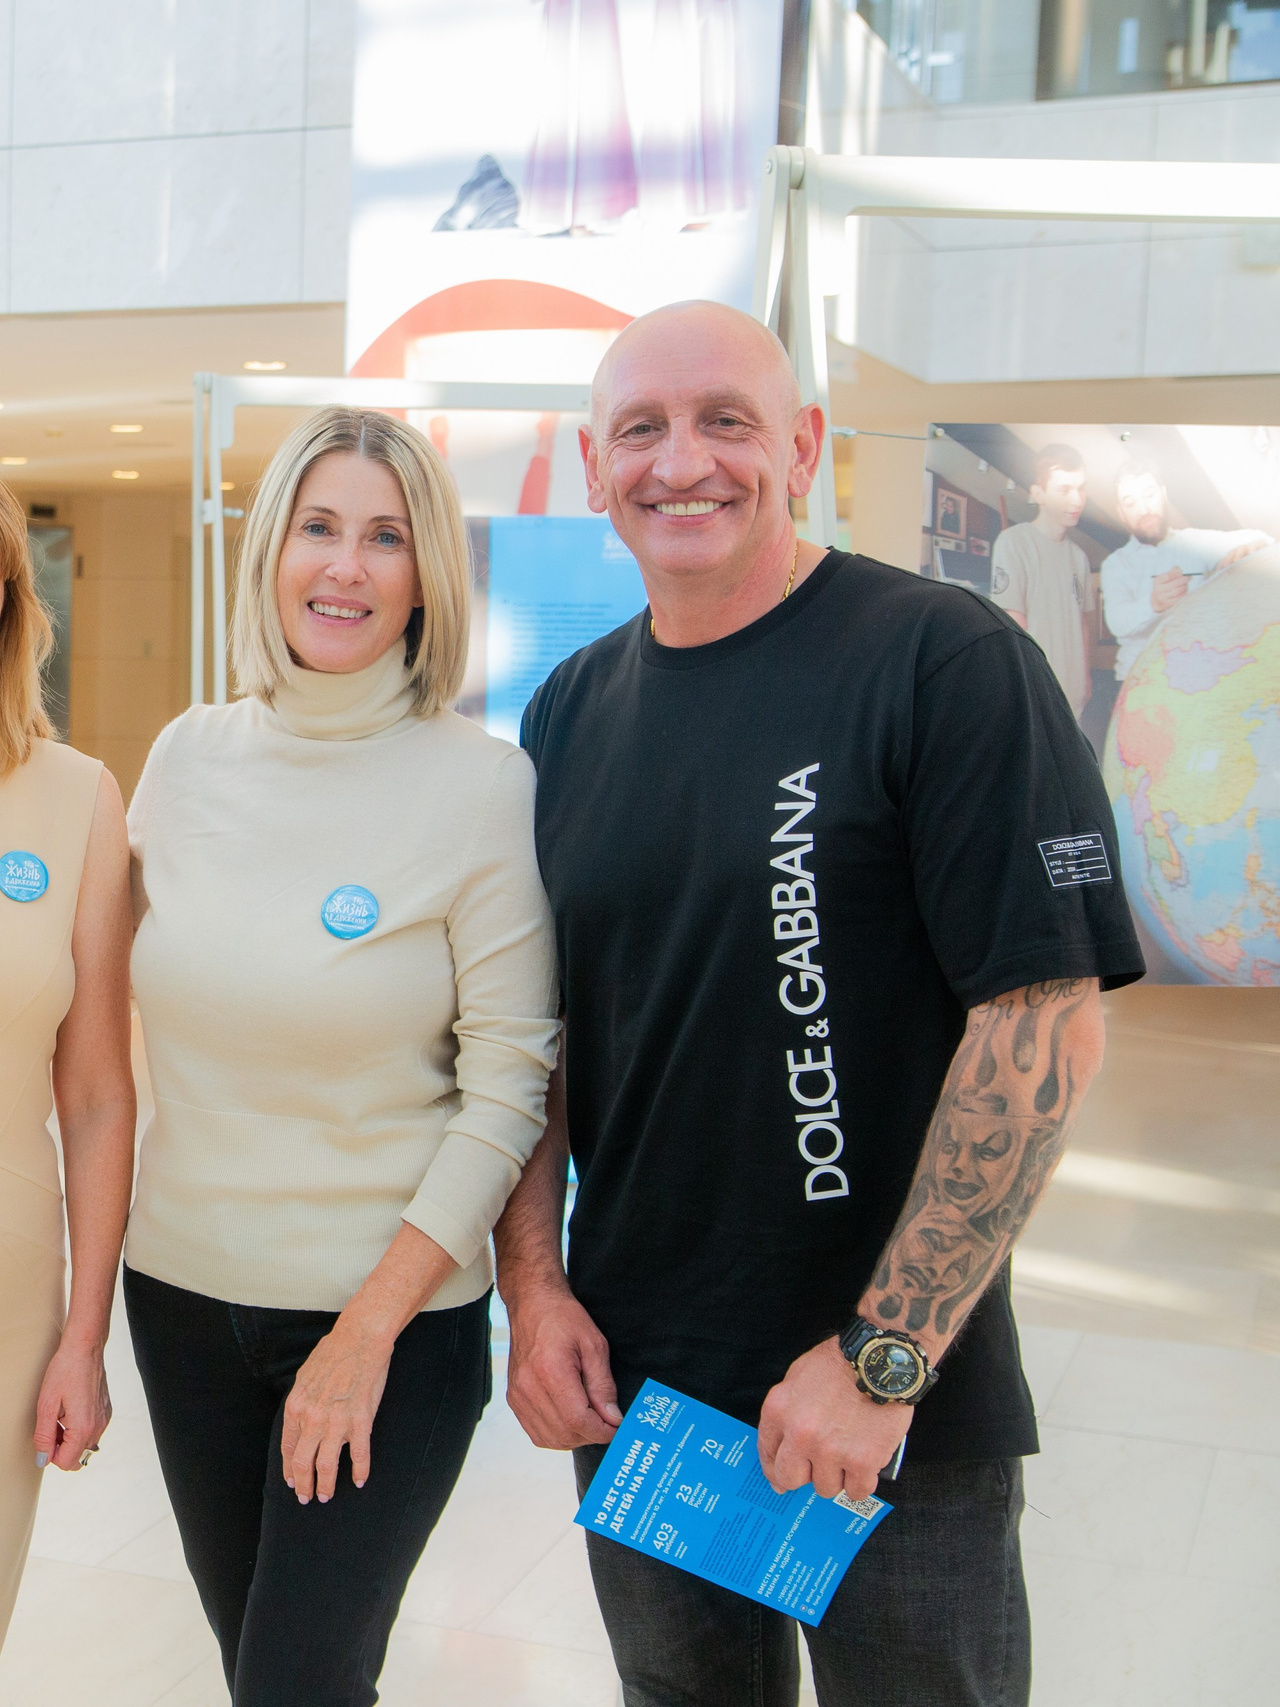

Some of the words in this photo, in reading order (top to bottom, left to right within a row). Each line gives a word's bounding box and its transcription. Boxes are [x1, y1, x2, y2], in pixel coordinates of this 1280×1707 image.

[5, 863, 40, 880] ЖИЗНЬ
[770, 762, 827, 1016] GABBANA
[332, 899, 369, 917] ЖИЗНЬ
[805, 1017, 829, 1038] &
[786, 1045, 850, 1201] DOLCE
[641, 1396, 670, 1427] ЖИЗНЬ
[700, 1439, 717, 1455] 70
[594, 1512, 607, 1525] 10
[602, 1487, 619, 1511] ЛЕТ
[614, 1440, 644, 1486] СТАВИМ
[610, 1493, 635, 1533] ДЕТЕЙ
[629, 1476, 644, 1492] НА
[638, 1442, 661, 1474] НОГИ
[657, 1471, 668, 1488] фонду
[676, 1485, 692, 1502] 23
[688, 1482, 703, 1506] региона
[693, 1488, 708, 1508] России
[653, 1523, 673, 1550] 403
[664, 1530, 678, 1554] ребенка
[757, 1573, 771, 1594] ВМЕСТЕ
[768, 1563, 776, 1573] МЫ
[774, 1541, 787, 1562] МОЖЕМ
[786, 1506, 809, 1540] ОСУЩЕСТВИТЬ
